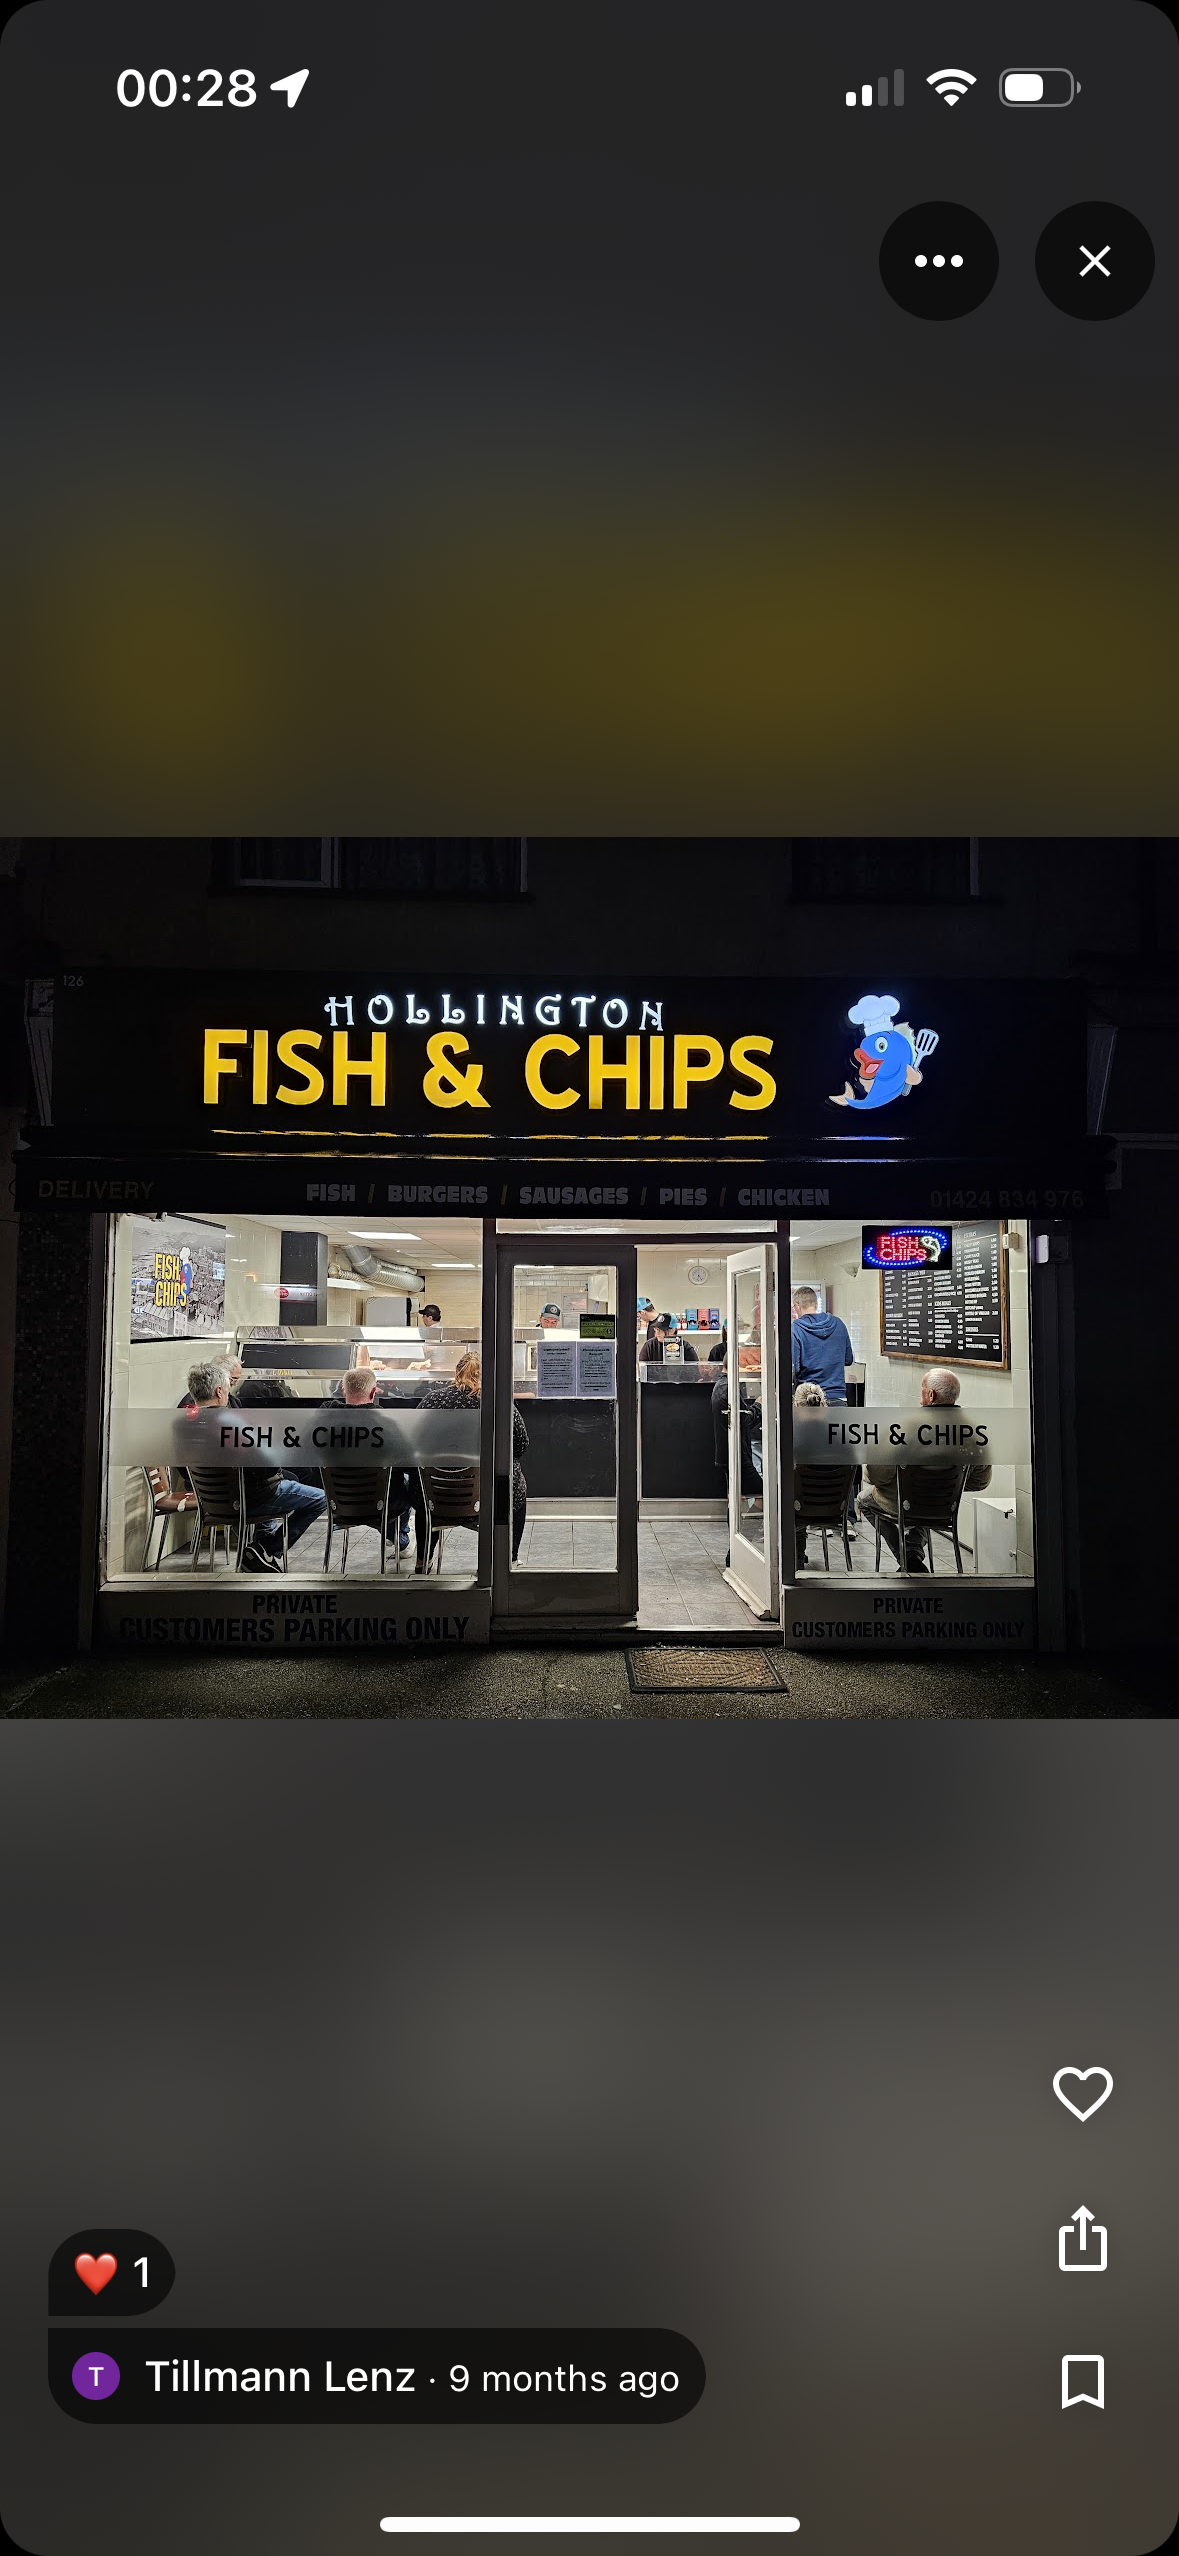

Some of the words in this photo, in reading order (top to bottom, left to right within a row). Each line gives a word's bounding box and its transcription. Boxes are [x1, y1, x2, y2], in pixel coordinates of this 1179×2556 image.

[63, 974, 84, 987] 126
[323, 994, 664, 1032] HOLLINGTON
[203, 1028, 387, 1107] FISH
[422, 1031, 492, 1109] &
[524, 1033, 777, 1111] CHIPS
[38, 1180, 154, 1200] DELIVERY
[306, 1183, 356, 1202] FISH
[388, 1184, 489, 1204] BURGERS
[519, 1186, 629, 1205] SAUSAGES
[659, 1188, 708, 1206] PIES
[737, 1188, 830, 1206] CHICKEN
[930, 1190, 992, 1209] 01424
[999, 1190, 1038, 1209] 834
[1044, 1190, 1084, 1208] 976
[880, 1236, 919, 1249] FISH
[880, 1248, 927, 1261] CHIPS
[154, 1253, 180, 1281] FISH
[155, 1281, 187, 1307] CHIPS
[220, 1426, 273, 1448] FISH
[283, 1426, 301, 1448] &
[312, 1426, 384, 1448] CHIPS
[828, 1423, 879, 1445] FISH
[889, 1423, 908, 1446] &
[917, 1424, 989, 1447] CHIPS
[252, 1594, 338, 1614] PRIVATE
[873, 1598, 944, 1614] PRIVATE
[119, 1616, 275, 1642] CUSTOMERS
[284, 1617, 397, 1642] PARKING
[405, 1616, 469, 1641] ONLY
[792, 1621, 896, 1638] CUSTOMERS
[902, 1621, 977, 1638] PARKING
[982, 1621, 1025, 1638] ONLY
